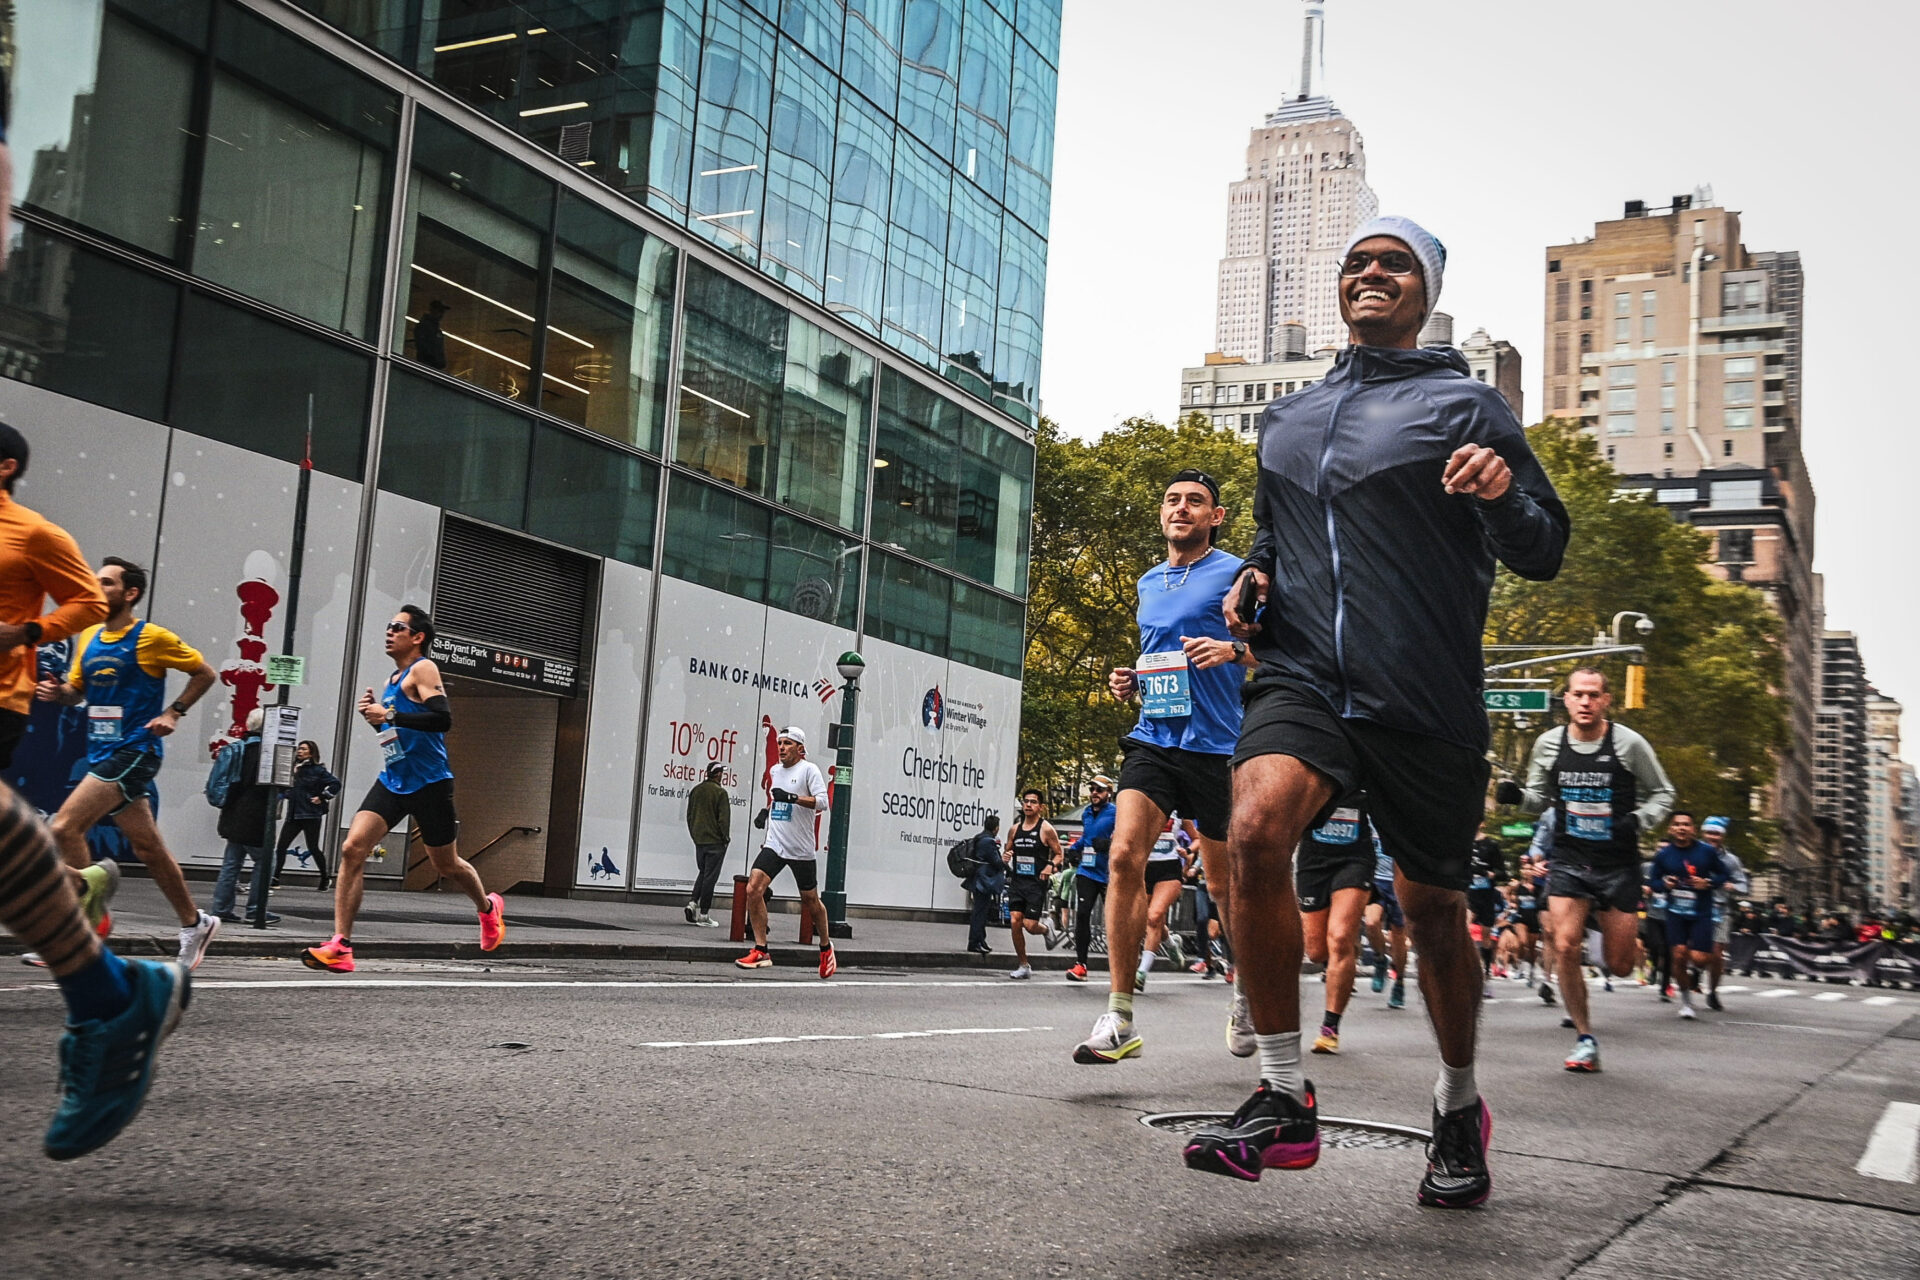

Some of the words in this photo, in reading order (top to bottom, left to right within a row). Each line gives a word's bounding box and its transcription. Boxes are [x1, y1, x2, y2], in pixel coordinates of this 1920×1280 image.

[430, 649, 450, 663] bway
[451, 653, 476, 667] Station
[433, 638, 470, 655] St-Bryant
[471, 646, 488, 659] Park
[690, 657, 728, 681] BANK
[732, 667, 750, 685] OF
[752, 672, 808, 700] AMERICA
[1140, 680, 1147, 696] B
[1147, 674, 1179, 696] 7673
[1170, 704, 1185, 714] 7673
[1486, 694, 1504, 707] 42
[1506, 694, 1522, 707] St
[946, 707, 966, 722] Winter
[968, 712, 987, 729] Village
[670, 721, 705, 756] 10%
[707, 729, 738, 763] off
[663, 759, 696, 782] skate
[698, 768, 738, 788] reals
[902, 746, 958, 785] Cherish
[962, 758, 985, 789] the
[648, 784, 658, 796] for
[660, 785, 676, 798] Bank
[676, 789, 684, 799] of
[882, 792, 935, 820] season
[900, 830, 912, 842] Find
[913, 834, 922, 844] out
[923, 835, 936, 846] more
[938, 838, 943, 846] at
